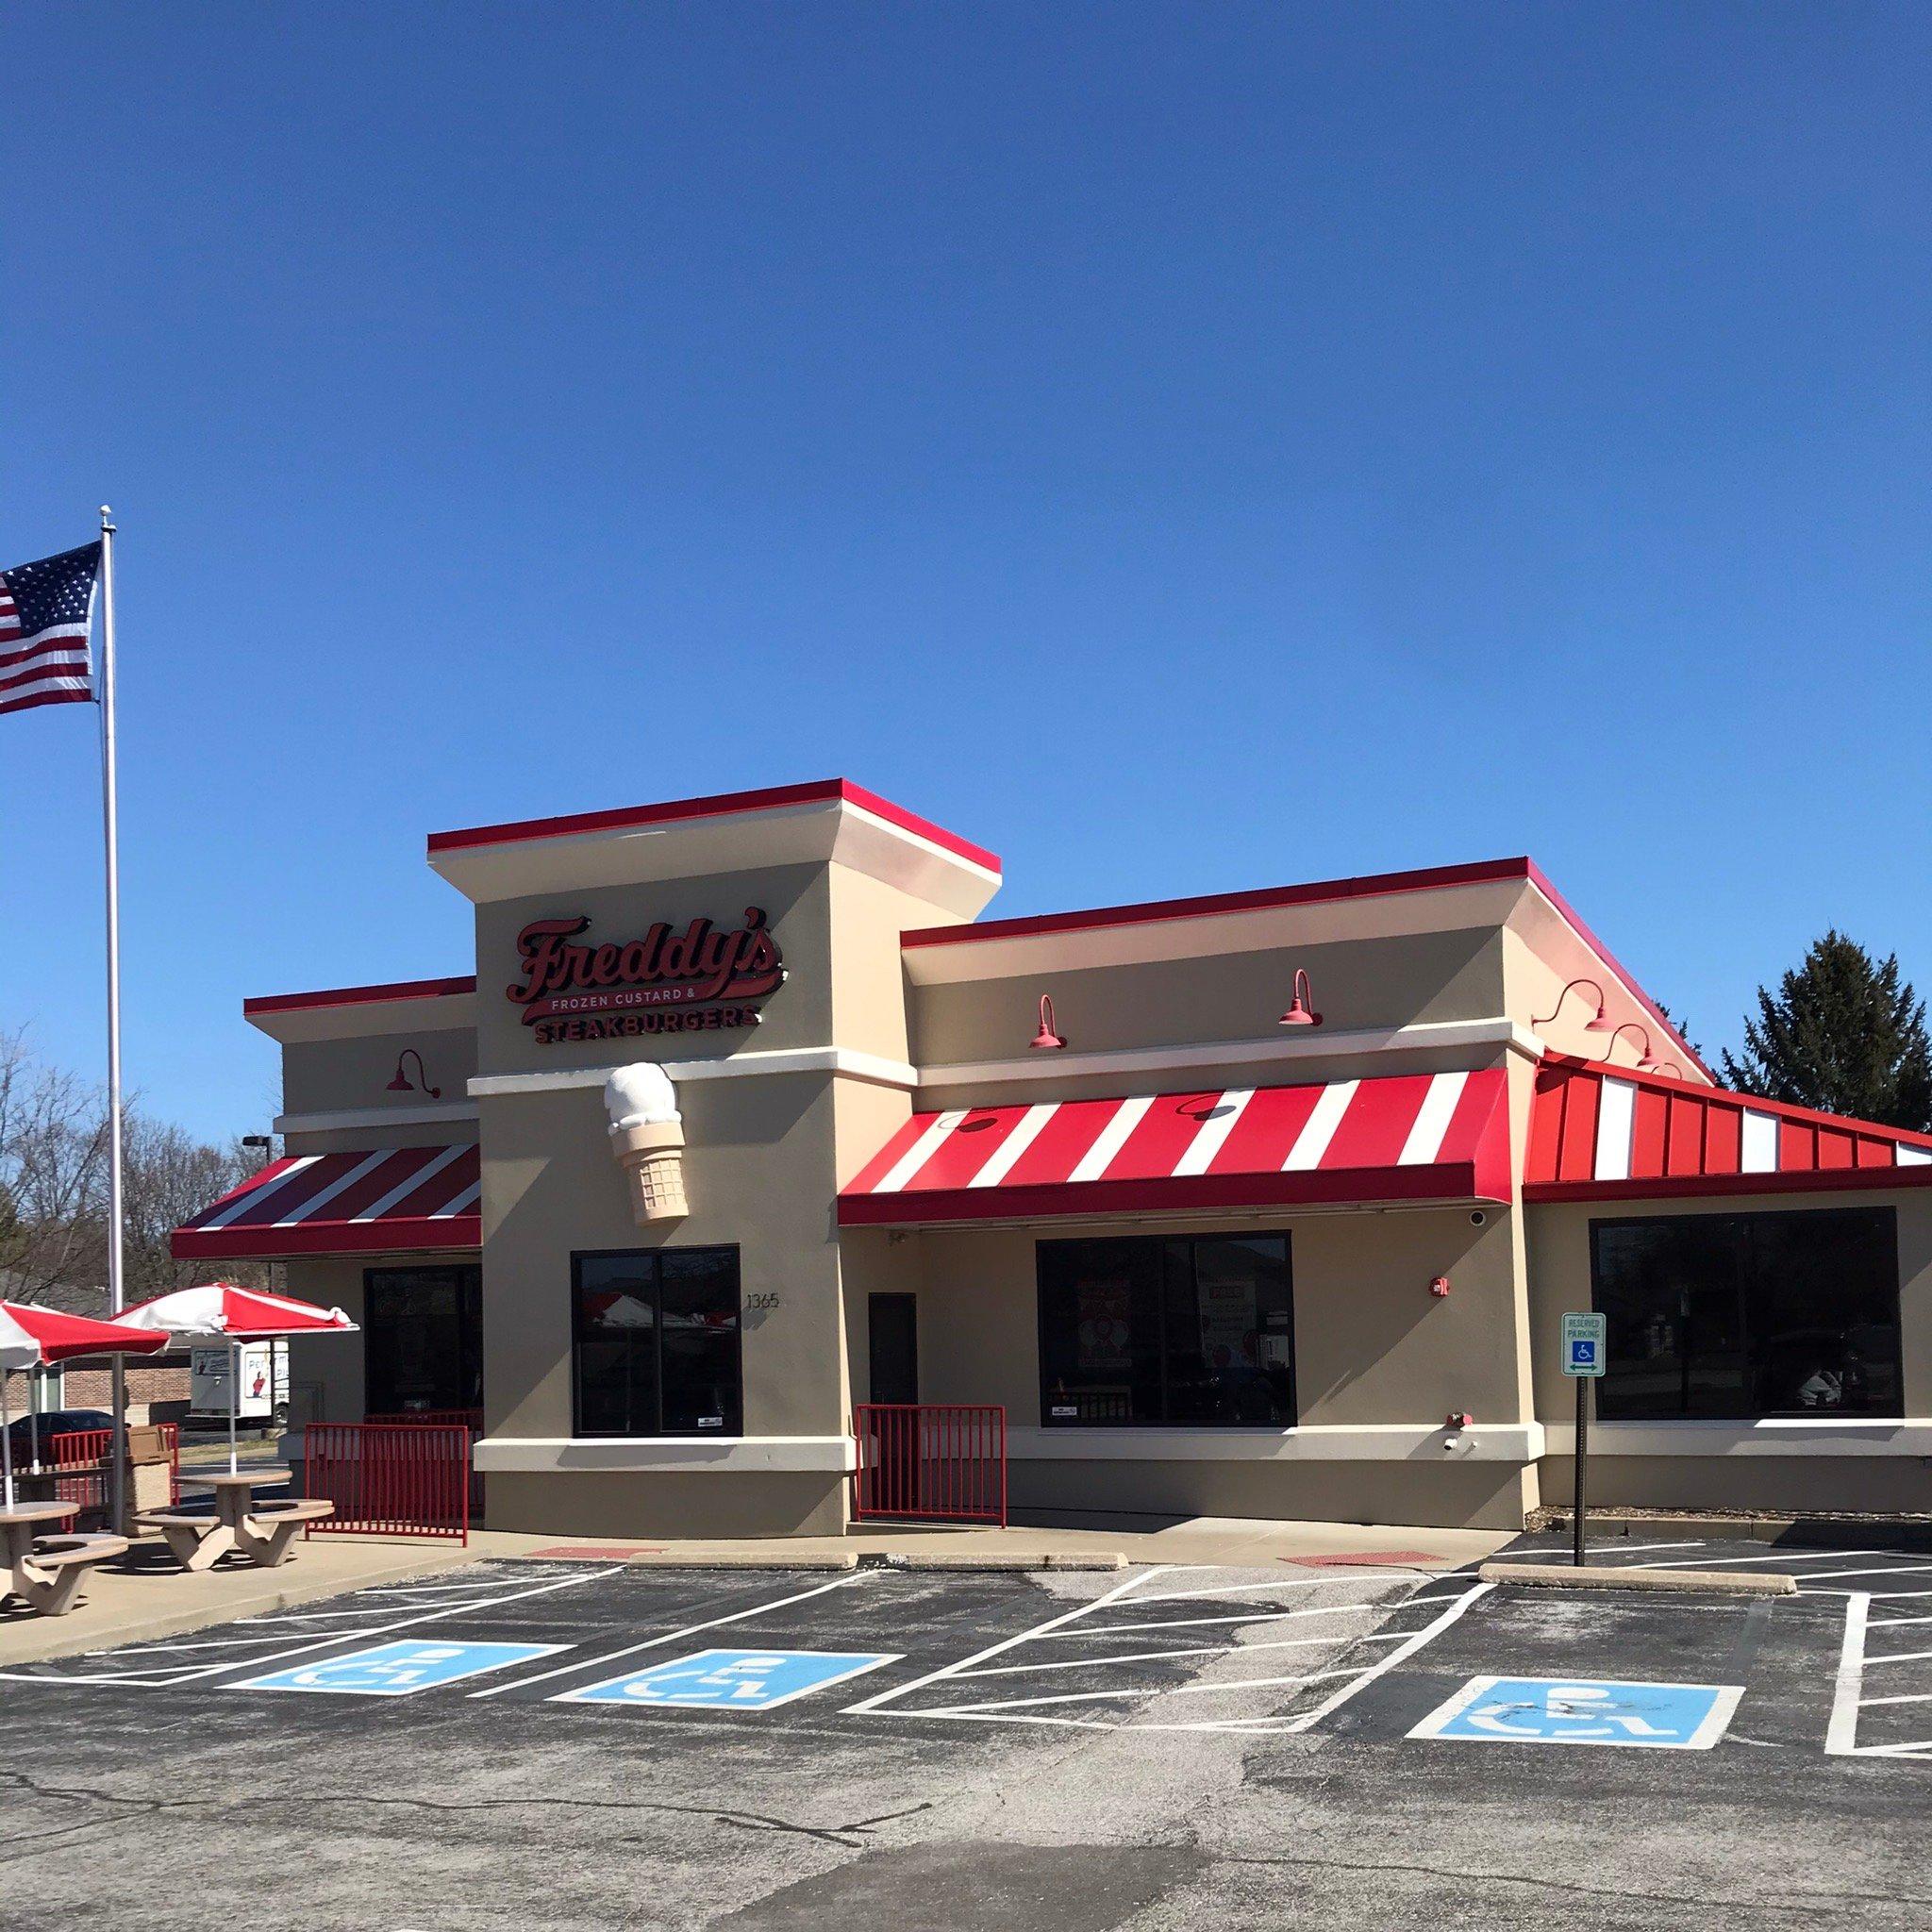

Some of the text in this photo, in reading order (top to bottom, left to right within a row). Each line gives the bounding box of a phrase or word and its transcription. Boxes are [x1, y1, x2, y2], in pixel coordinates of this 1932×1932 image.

[506, 906, 785, 1004] Freddy's
[551, 988, 695, 1010] FROZEN CUSTARD &
[534, 1005, 760, 1044] STEAKBURGERS
[747, 1291, 779, 1308] 1365
[1569, 1319, 1600, 1328] RESERVED
[1568, 1330, 1600, 1339] PARKING
